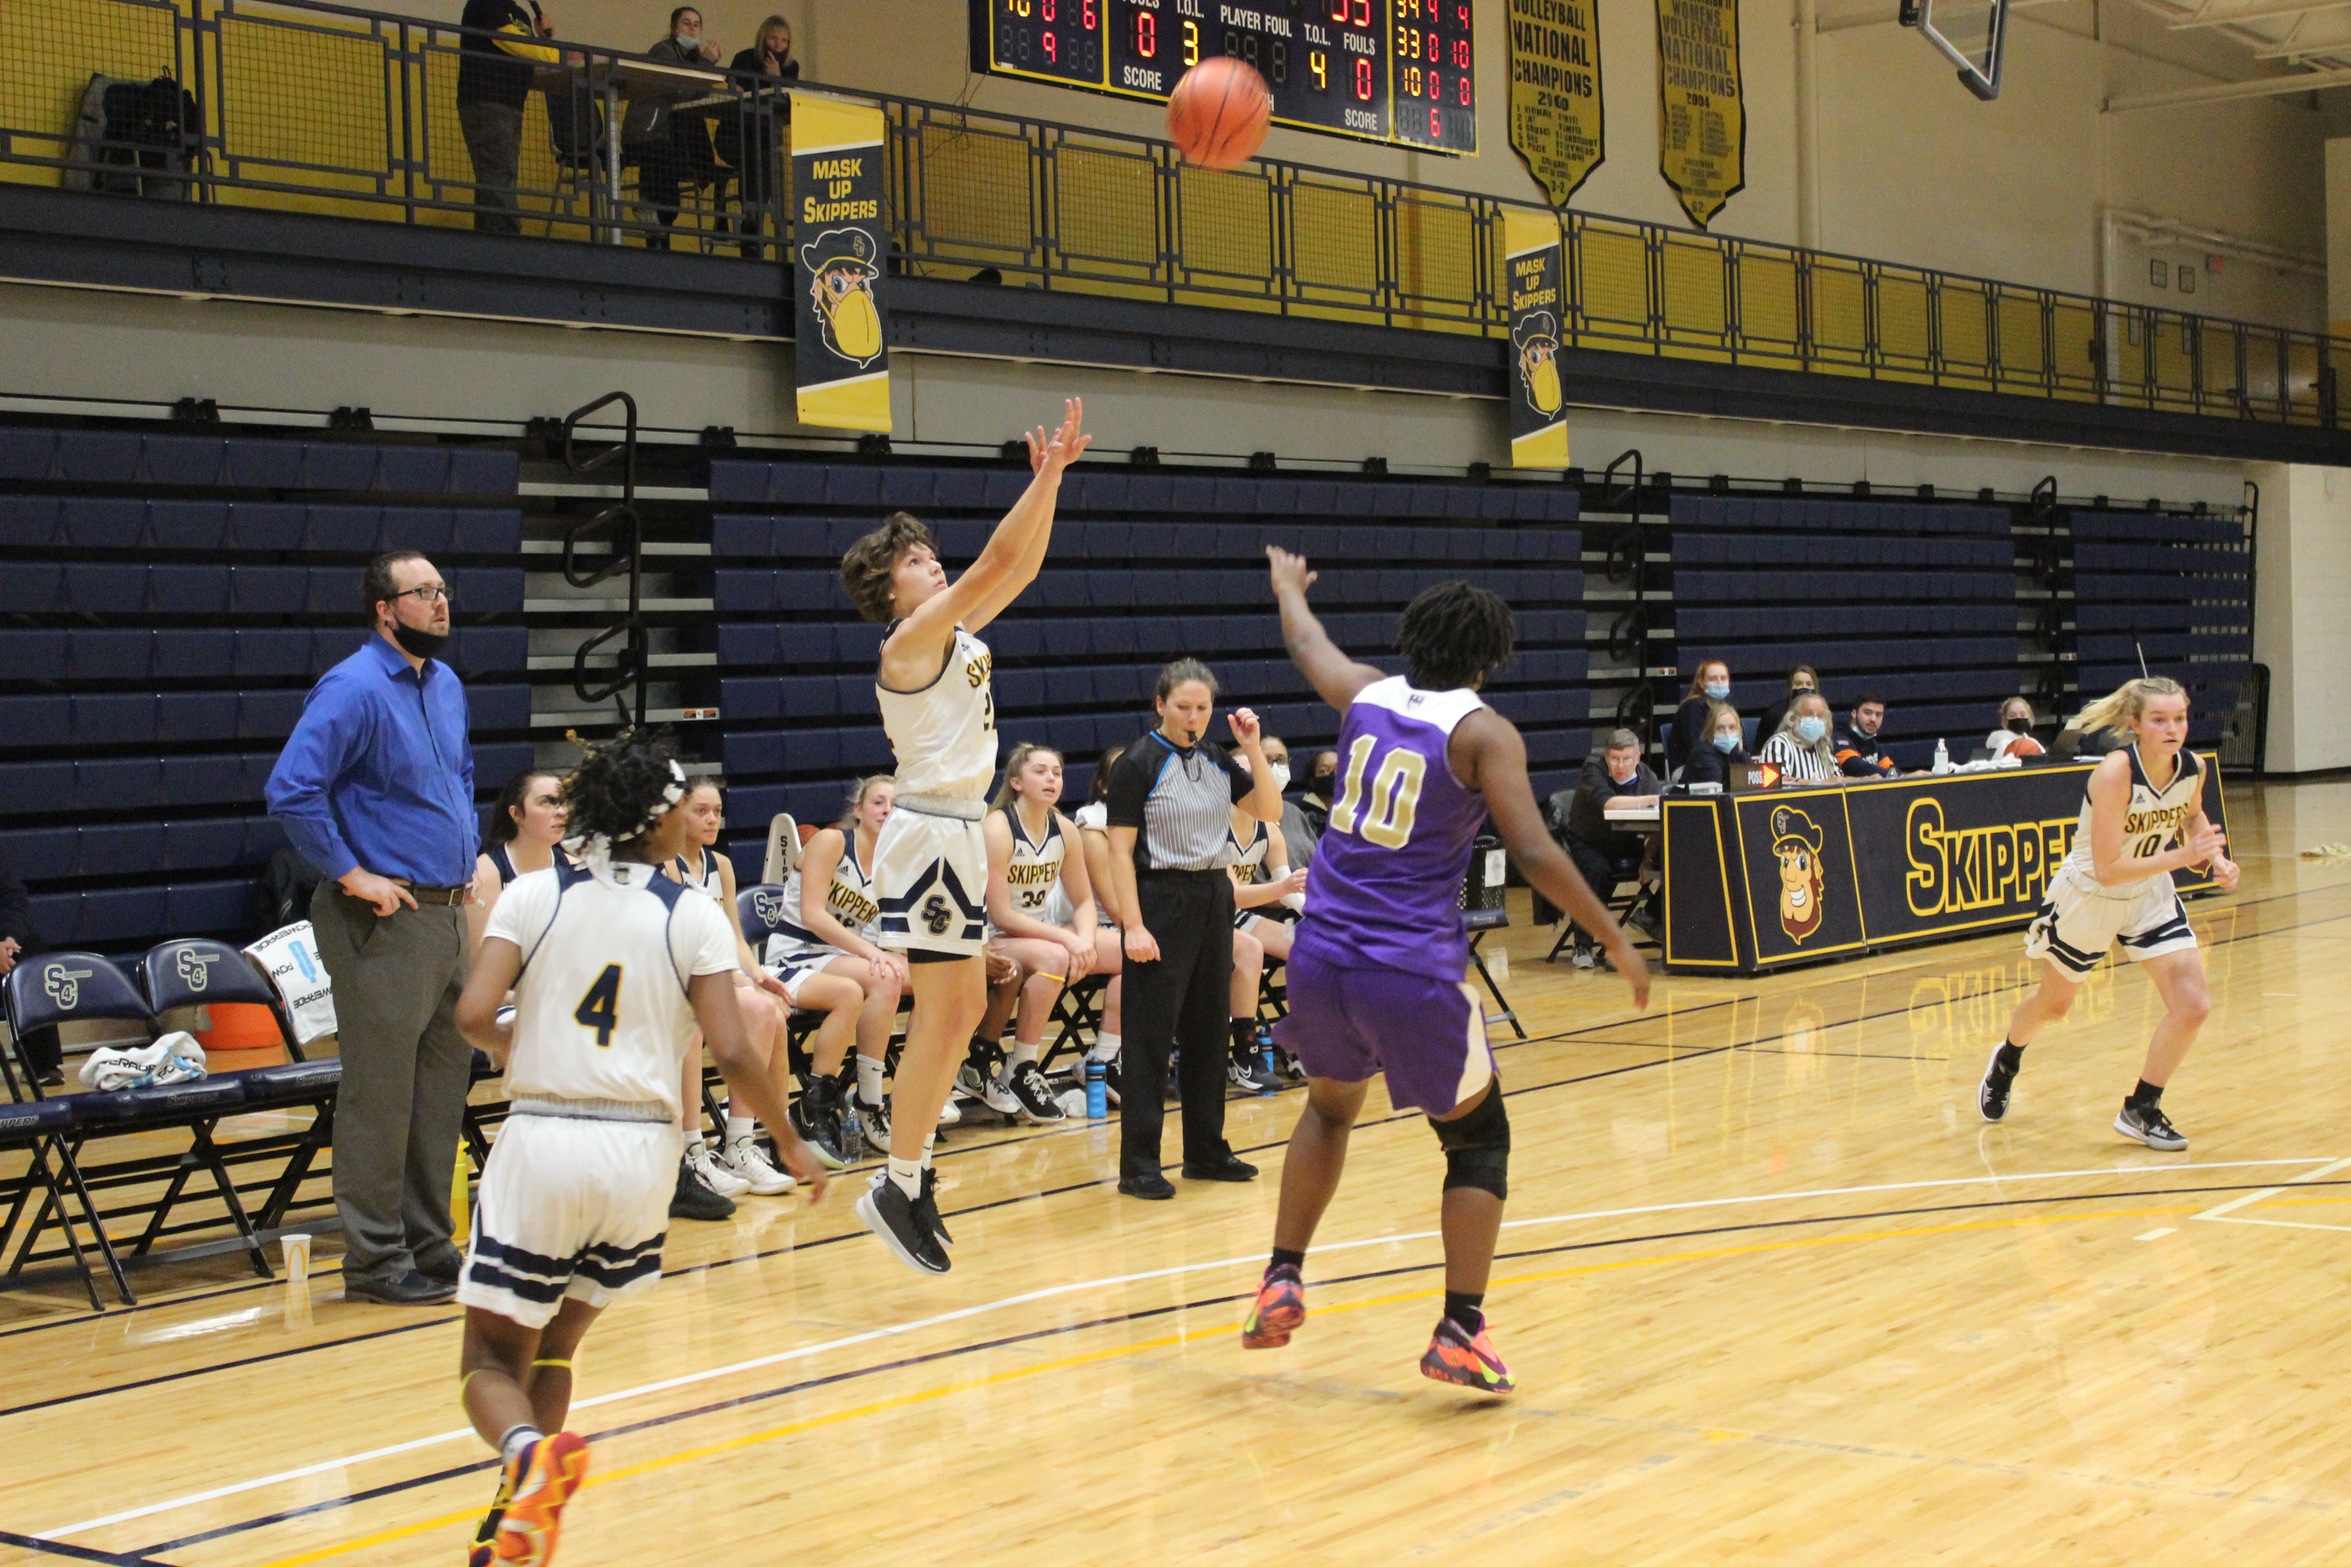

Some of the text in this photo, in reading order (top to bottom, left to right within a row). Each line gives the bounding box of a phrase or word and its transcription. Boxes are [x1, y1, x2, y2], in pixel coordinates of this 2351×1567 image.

[1220, 5, 1293, 38] PLAYER FOUL
[1457, 5, 1469, 30] 4
[1514, 0, 1585, 32] VOLLEYBALL
[1042, 32, 1056, 63] 9
[1137, 11, 1198, 66] 0 3
[1304, 23, 1331, 46] T.O.L.
[1343, 32, 1376, 56] FOULS
[1397, 25, 1421, 59] 33
[1453, 39, 1470, 69] 10
[1513, 19, 1590, 67] NATIONAL
[1664, 35, 1732, 76] NATIONAL
[1123, 65, 1162, 91] SCORE
[1310, 51, 1372, 101] 4 0
[1404, 66, 1422, 97] 10
[1515, 58, 1592, 98] CHAMPIONS
[1667, 64, 1735, 98] CHAMPIONS
[1345, 108, 1378, 131] SCORE
[1429, 108, 1441, 138] 6
[813, 158, 863, 180] MASK
[829, 180, 852, 200] UP
[803, 196, 878, 224] SKIPPERS
[1516, 257, 1546, 277] MASK
[1526, 275, 1540, 291] UP
[1512, 288, 1556, 312] SKIPPERS
[1329, 733, 1427, 851] 10
[1906, 797, 2080, 917] SKIPPE
[2133, 833, 2162, 859] 10
[292, 986, 333, 1010] WERADE
[575, 962, 624, 1048] 4
